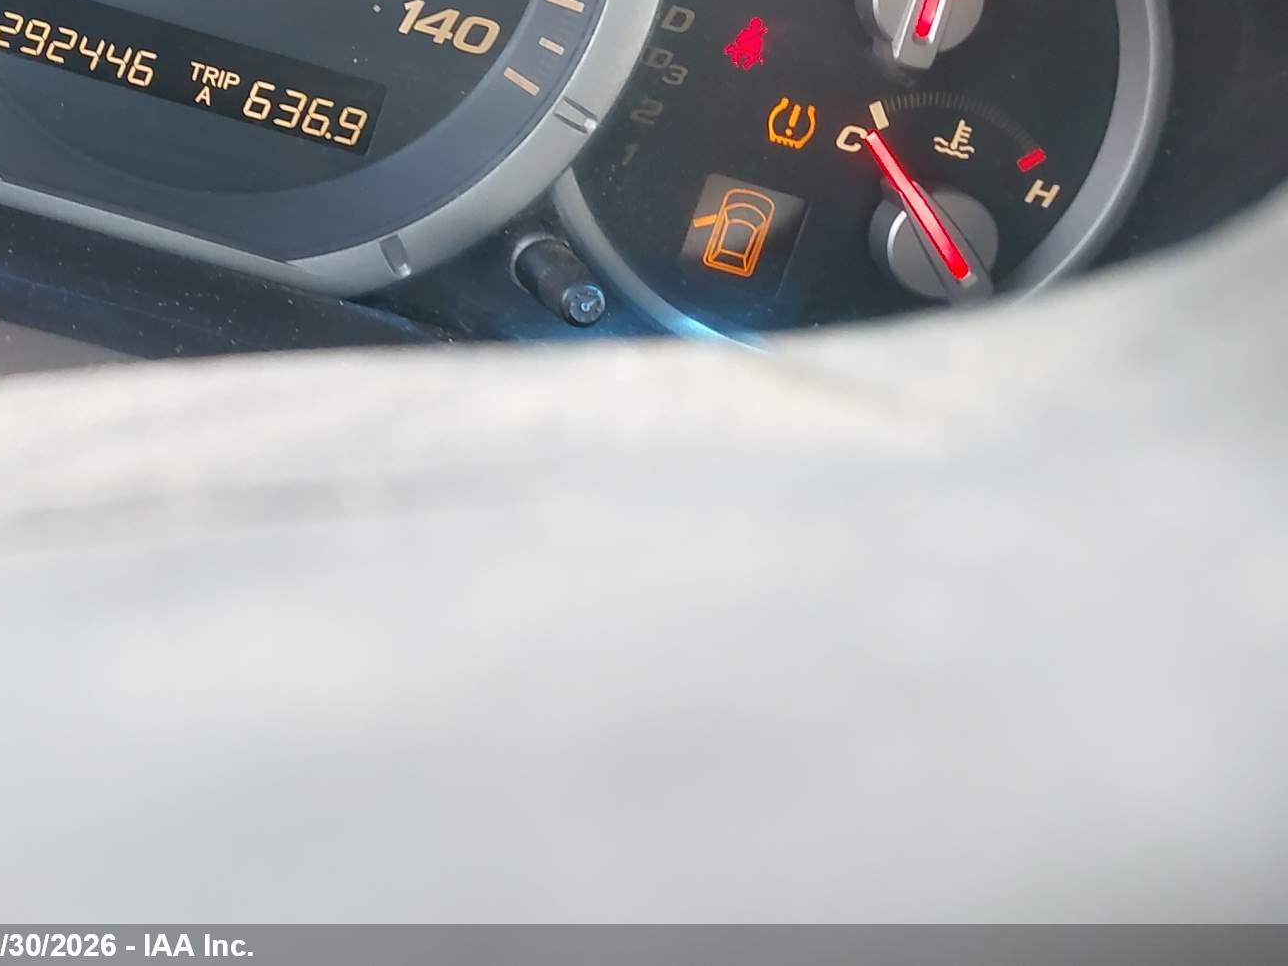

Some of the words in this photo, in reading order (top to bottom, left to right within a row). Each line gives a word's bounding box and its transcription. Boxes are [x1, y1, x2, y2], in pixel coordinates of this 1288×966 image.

[189, 60, 242, 91] TRIP
[194, 85, 212, 107] A
[242, 80, 368, 146] 636.9
[629, 98, 663, 125] 2
[835, 124, 868, 153] C
[1024, 178, 1061, 209] H
